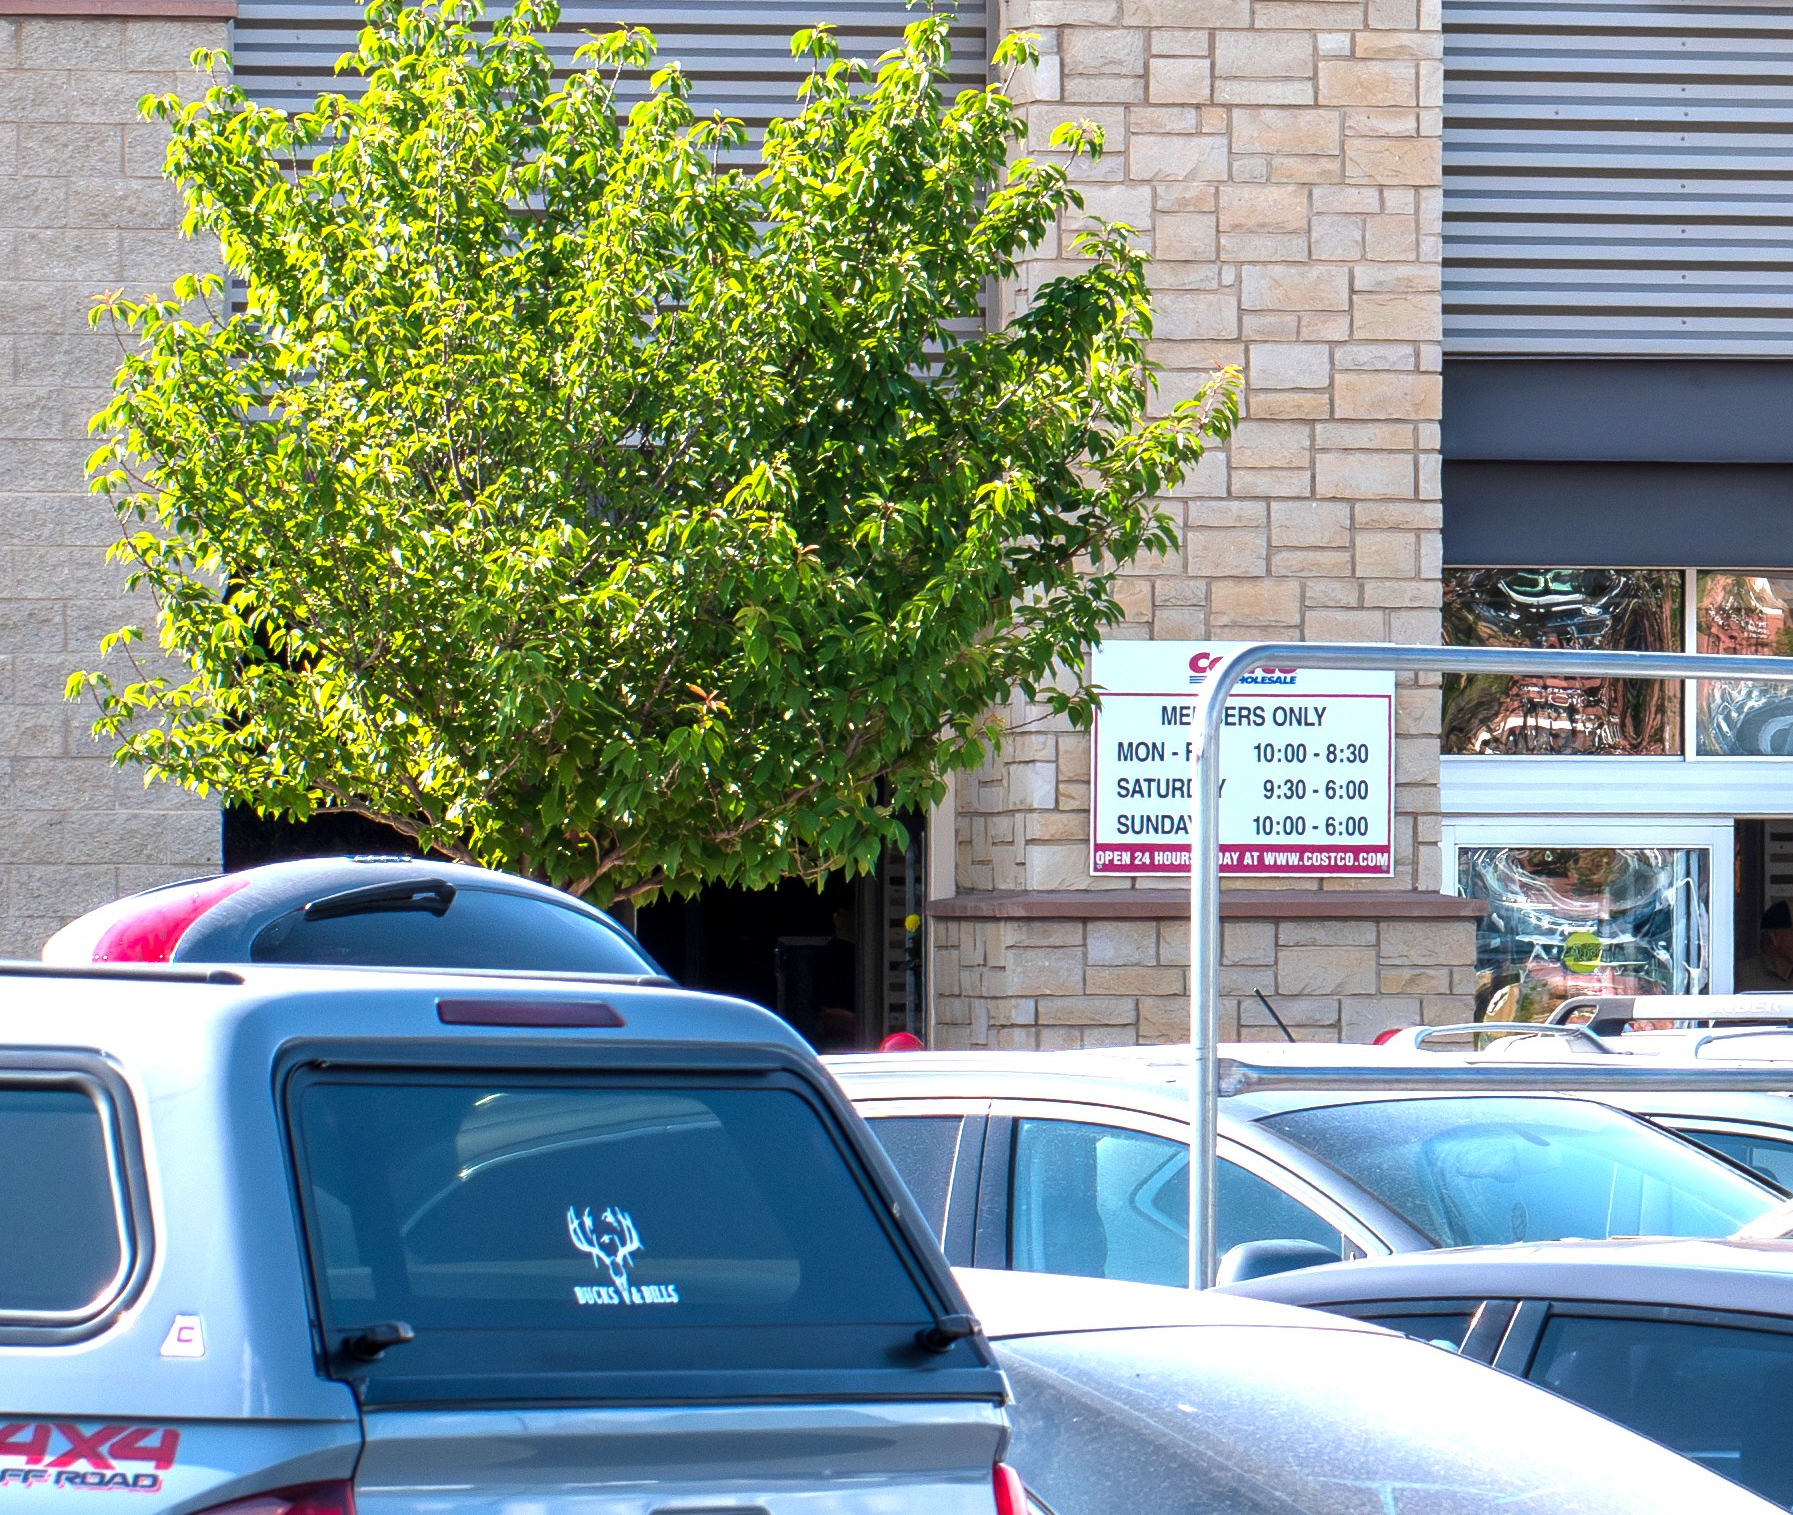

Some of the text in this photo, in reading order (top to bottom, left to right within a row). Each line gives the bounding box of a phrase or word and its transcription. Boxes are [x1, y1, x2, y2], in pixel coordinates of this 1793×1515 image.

[1237, 676, 1297, 684] HOLESALE
[1161, 706, 1327, 726] MEERS ONLY
[1117, 741, 1165, 762] MON
[1254, 742, 1307, 763] 10:00
[1326, 743, 1369, 763] 8:30
[1117, 778, 1226, 798] SATURY
[1263, 779, 1306, 799] 9:30
[1325, 780, 1368, 800] 6:00
[1253, 815, 1306, 835] 10:00
[1325, 816, 1368, 836] 6:00
[1096, 851, 1130, 865] OPEN
[1134, 851, 1150, 865] 24
[1154, 851, 1192, 865] HOUR
[1244, 852, 1260, 865] AT
[1264, 852, 1388, 867] WWW.COSTCO.COM
[574, 1285, 620, 1304] BUCKS
[641, 1285, 679, 1303] BILLS
[0, 1422, 181, 1471] 4X4
[54, 1470, 160, 1492] ROAD
